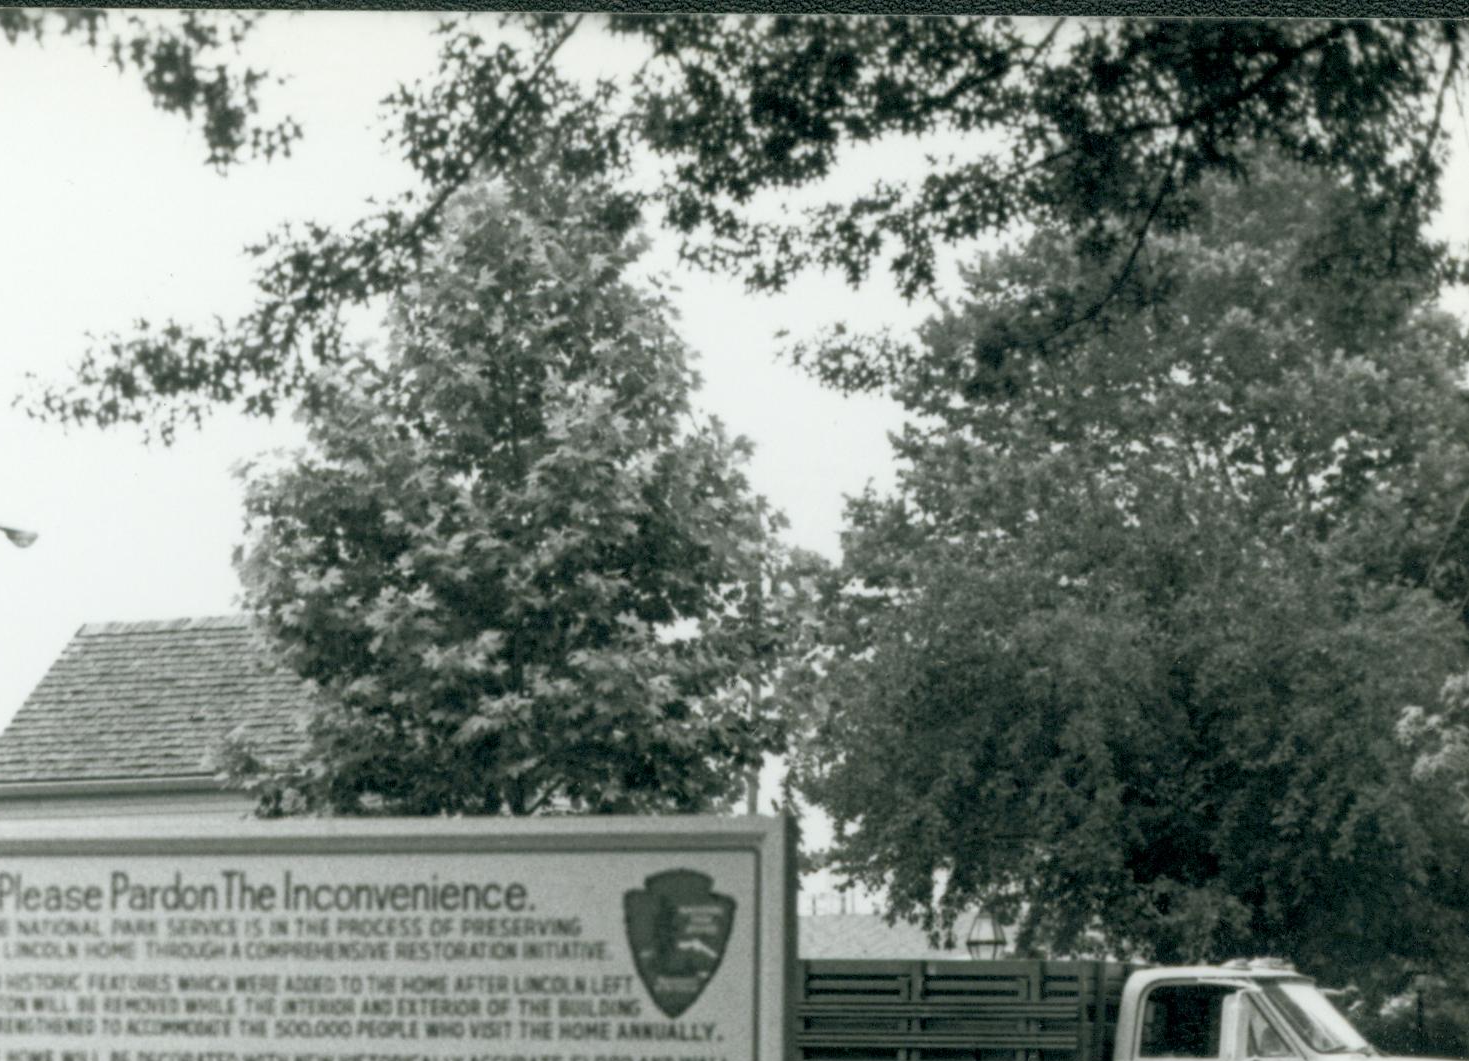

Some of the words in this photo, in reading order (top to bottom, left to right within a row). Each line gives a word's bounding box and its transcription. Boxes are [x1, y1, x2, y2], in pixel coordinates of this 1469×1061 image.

[110, 870, 218, 911] Pardon
[221, 870, 276, 911] The
[283, 868, 536, 911] Inconvenience.
[17, 919, 102, 936] NATIONAL
[111, 919, 157, 936] PARK
[167, 918, 237, 937] SERVICE
[244, 917, 264, 938] IS
[270, 919, 288, 936] IN
[295, 917, 329, 937] THE
[336, 917, 423, 938] PROCESS
[429, 917, 454, 937] OF
[461, 917, 582, 937] PRESERVING
[5, 941, 78, 960] LINCOLN
[145, 940, 227, 960] THROUGH
[229, 941, 241, 959] A
[245, 940, 390, 961] COMPREHENSIVE
[395, 940, 518, 961] RESTORATION
[5, 972, 80, 992] HISTORIC
[87, 973, 172, 993] FEATURES
[177, 975, 230, 993] WHICH
[234, 974, 279, 994] WERE
[284, 975, 336, 994] ADDED
[339, 974, 363, 994] TO
[366, 974, 396, 994] THE
[401, 976, 448, 994] HOME
[453, 974, 509, 994] AFTER
[513, 975, 587, 995] LINCOLN
[590, 975, 633, 995] LEFT
[32, 996, 68, 1013] WILL
[76, 996, 96, 1014] BE
[103, 996, 179, 1014] REMOVED
[184, 997, 236, 1015] WHILE
[245, 996, 276, 1015] THE
[282, 998, 355, 1016] INTERIOR
[361, 999, 393, 1016] AND
[397, 997, 481, 1017] EXTERIOR
[486, 997, 510, 1017] OF
[518, 998, 551, 1017] THE
[558, 998, 641, 1018] BUILDING
[101, 1017, 123, 1036] TO
[126, 1018, 231, 1037] ACCOMMODATE
[239, 1018, 267, 1037] THE
[356, 1019, 418, 1039] PEOPLE
[424, 1020, 465, 1039] WHO
[469, 1019, 512, 1040] VISIT
[518, 1020, 553, 1041] THE
[558, 1021, 610, 1041] HOME
[616, 1022, 723, 1042] ANNUALLY.
